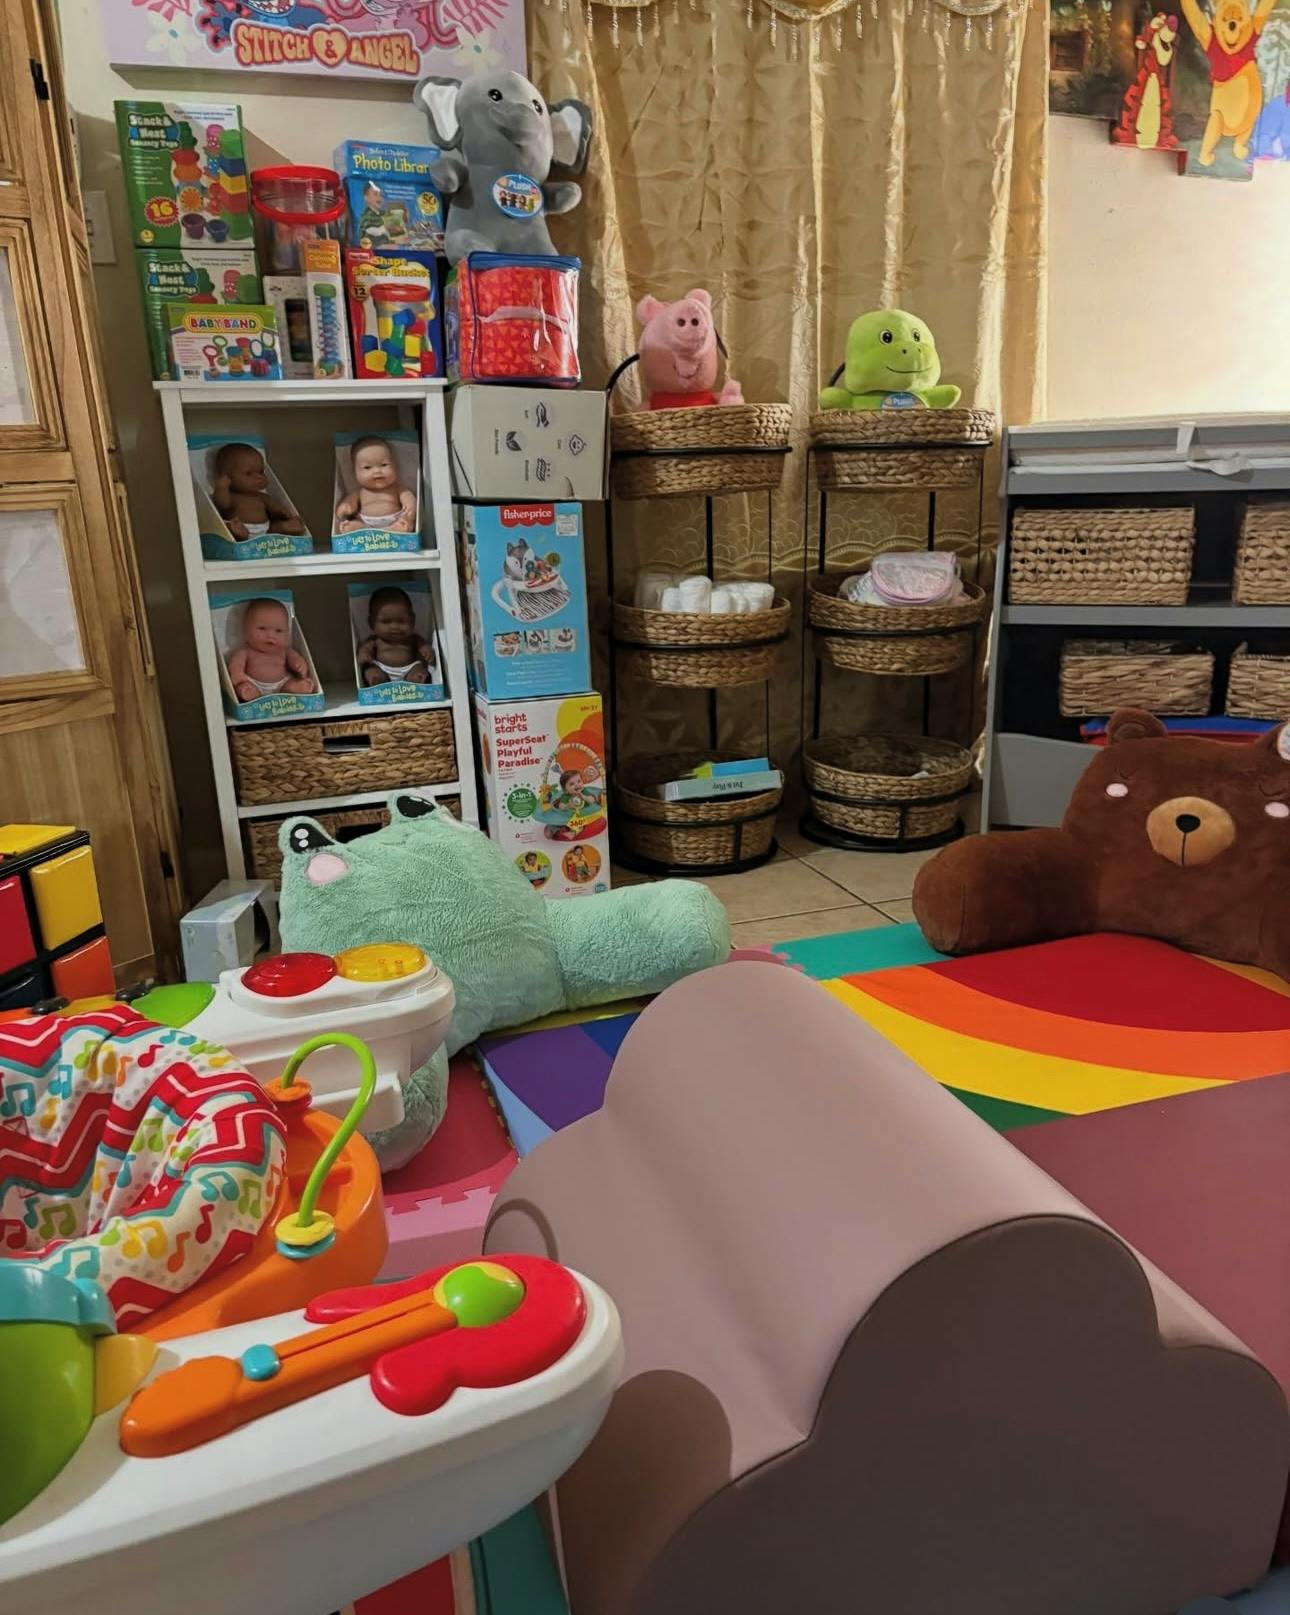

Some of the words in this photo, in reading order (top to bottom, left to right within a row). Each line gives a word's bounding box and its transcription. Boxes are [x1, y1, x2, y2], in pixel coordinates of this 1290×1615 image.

[236, 24, 312, 65] STITCH
[323, 39, 338, 59] &
[350, 36, 418, 74] ANGEL
[129, 114, 163, 126] Stack
[139, 127, 167, 139] Nest
[353, 154, 391, 172] Photo
[394, 158, 429, 174] Librar
[150, 201, 174, 217] 16
[373, 256, 408, 267] Shape
[149, 262, 182, 273] Stack
[159, 274, 185, 285] Nest
[354, 287, 367, 296] 12
[190, 318, 222, 329] BABY
[224, 318, 257, 329] BAND
[495, 713, 527, 725] bright
[495, 723, 528, 734] starts
[496, 735, 546, 747] SuperSeat
[497, 746, 532, 757] Playful
[498, 757, 540, 768] Paradise
